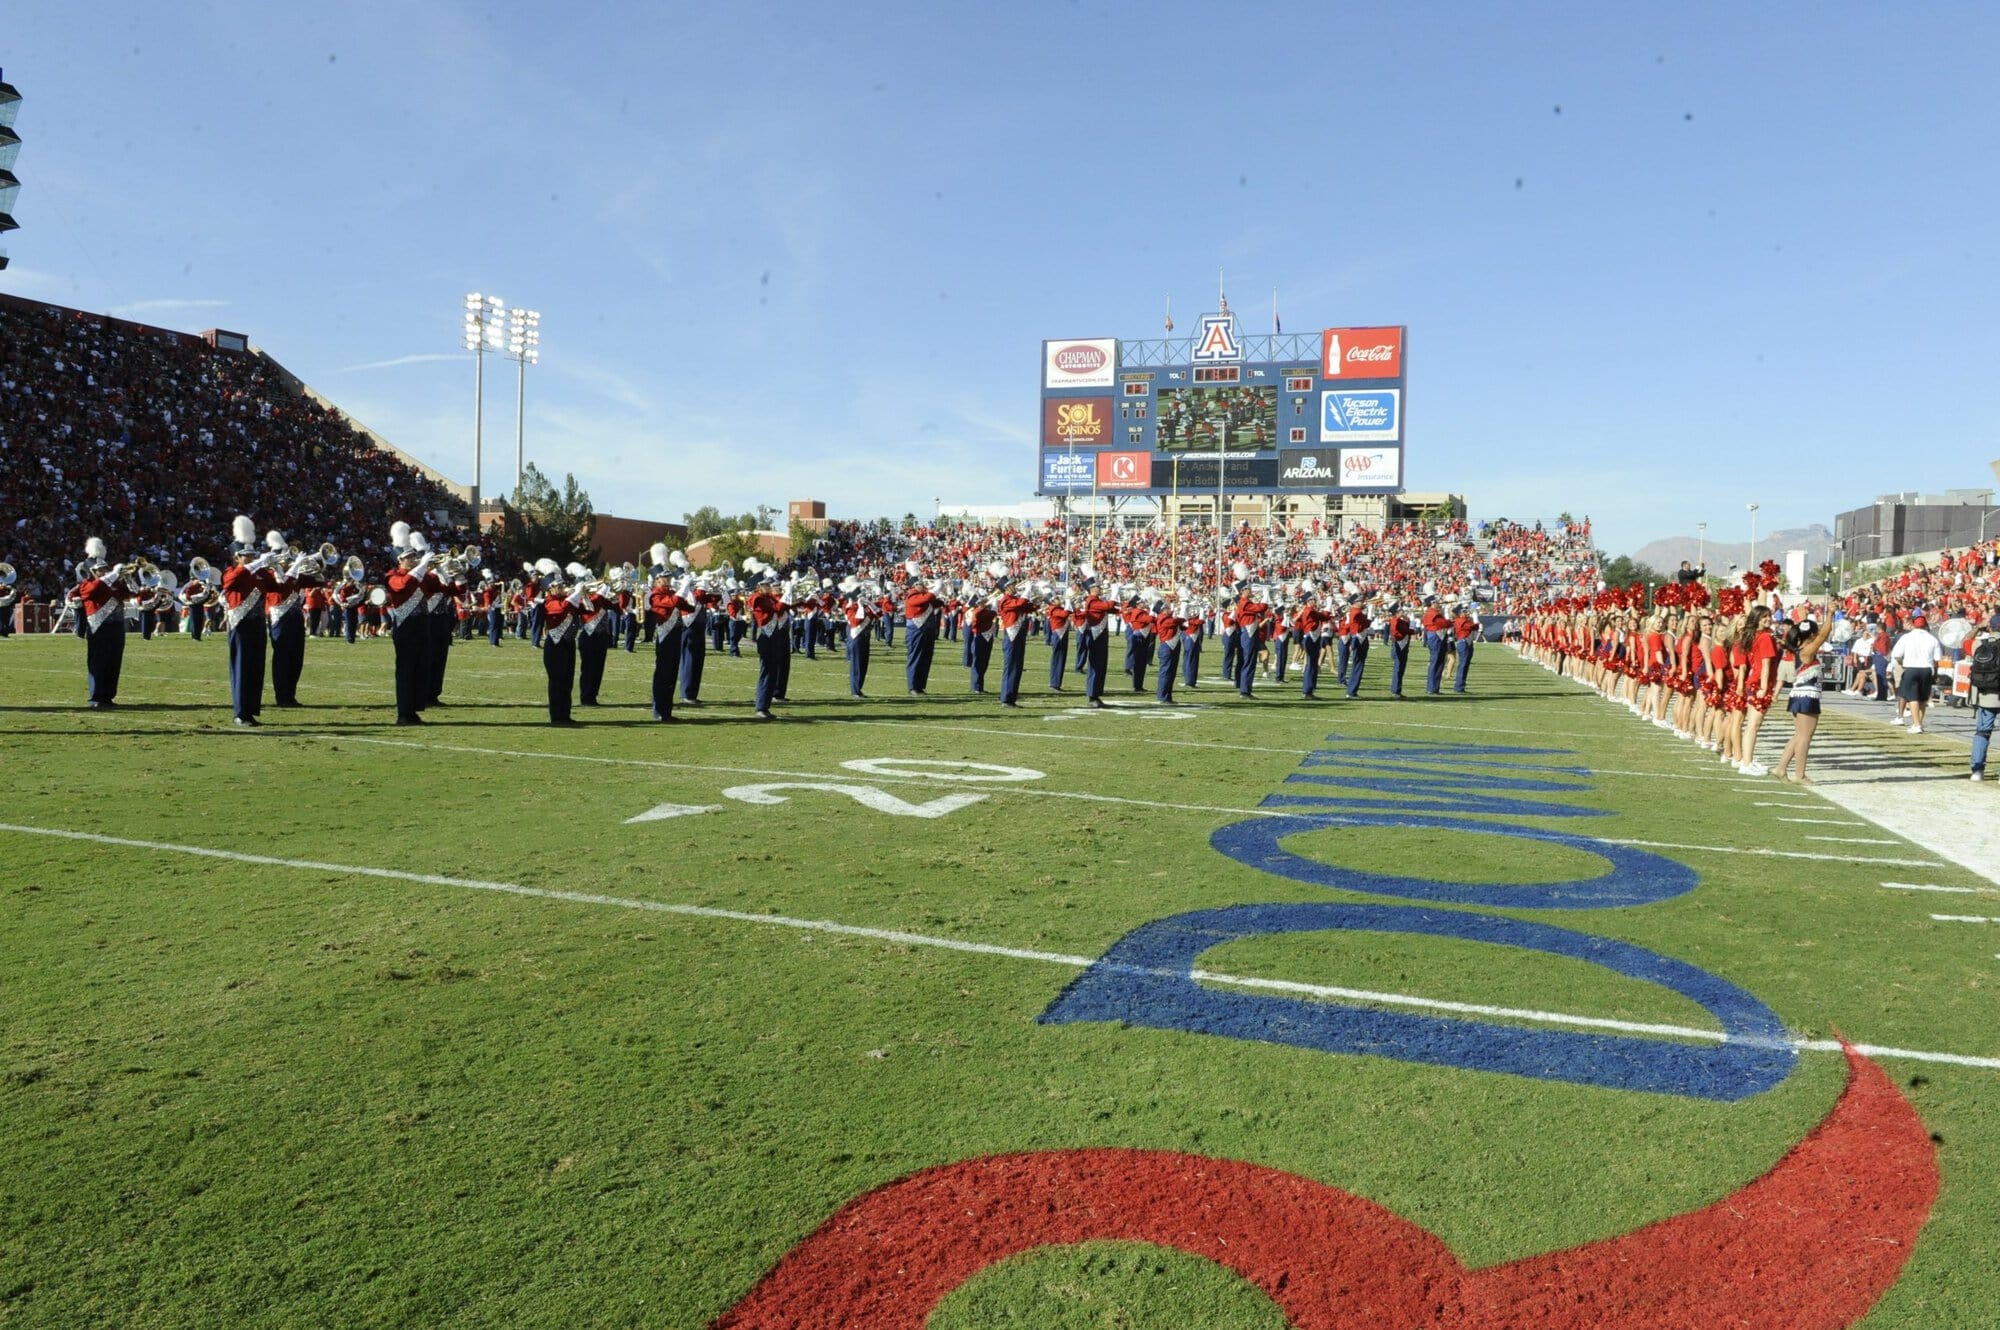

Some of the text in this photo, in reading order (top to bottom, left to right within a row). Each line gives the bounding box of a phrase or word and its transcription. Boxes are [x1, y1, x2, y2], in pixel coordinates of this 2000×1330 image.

[1194, 319, 1240, 360] A
[1059, 351, 1101, 364] CHAPMAN
[1346, 345, 1395, 362] Coca-Cola
[1342, 397, 1379, 408] Tucson
[1057, 404, 1101, 425] SOL
[1346, 407, 1388, 417] Electric
[1350, 416, 1387, 426] Power
[1057, 425, 1101, 435] CASINOS
[1057, 455, 1082, 465] Jack
[1346, 456, 1370, 471] AAA
[1231, 462, 1249, 471] and
[1283, 468, 1332, 478] ARIZONA
[1357, 473, 1394, 481] Insurance
[722, 757, 1046, 819] 20
